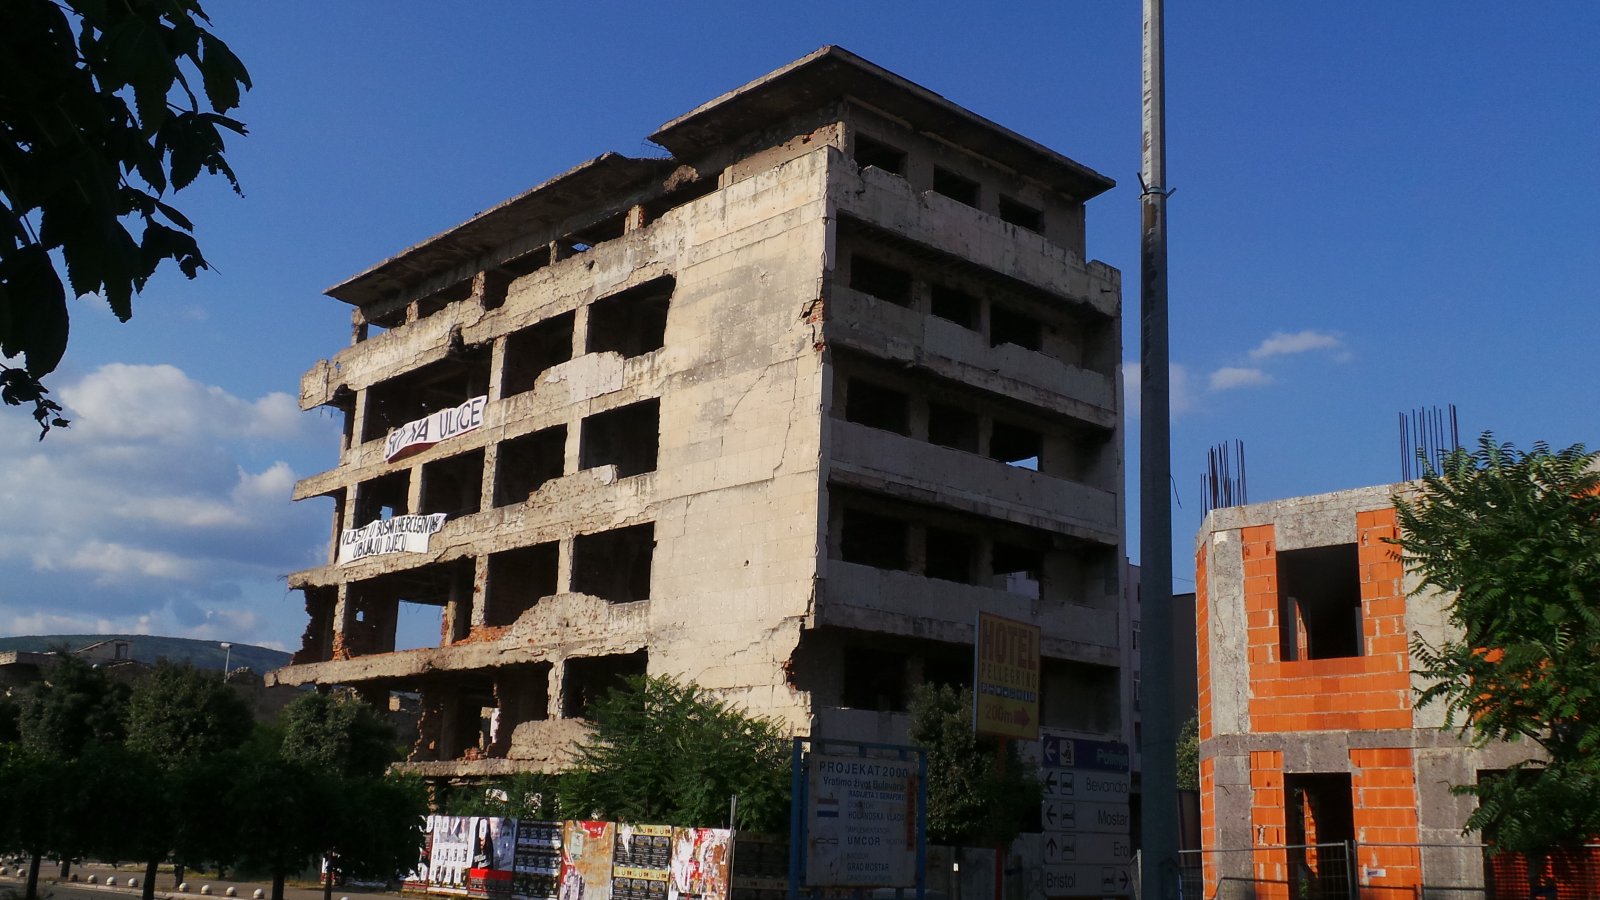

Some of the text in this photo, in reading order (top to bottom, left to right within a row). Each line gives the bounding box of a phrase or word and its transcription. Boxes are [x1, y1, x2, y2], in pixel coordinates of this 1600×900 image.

[439, 399, 482, 439] ULICE
[385, 533, 407, 552] DJECU
[982, 620, 1037, 670] HOTEL
[985, 703, 1013, 725] 200m
[819, 761, 909, 778] PROJEKAT 2000
[823, 777, 851, 787] Vratimo
[1097, 809, 1129, 826] Mostar
[847, 836, 881, 846] UMCOR
[1113, 841, 1129, 857] Ero
[847, 862, 889, 873] GRAD MOSTAR
[1046, 872, 1076, 889] Bristol
